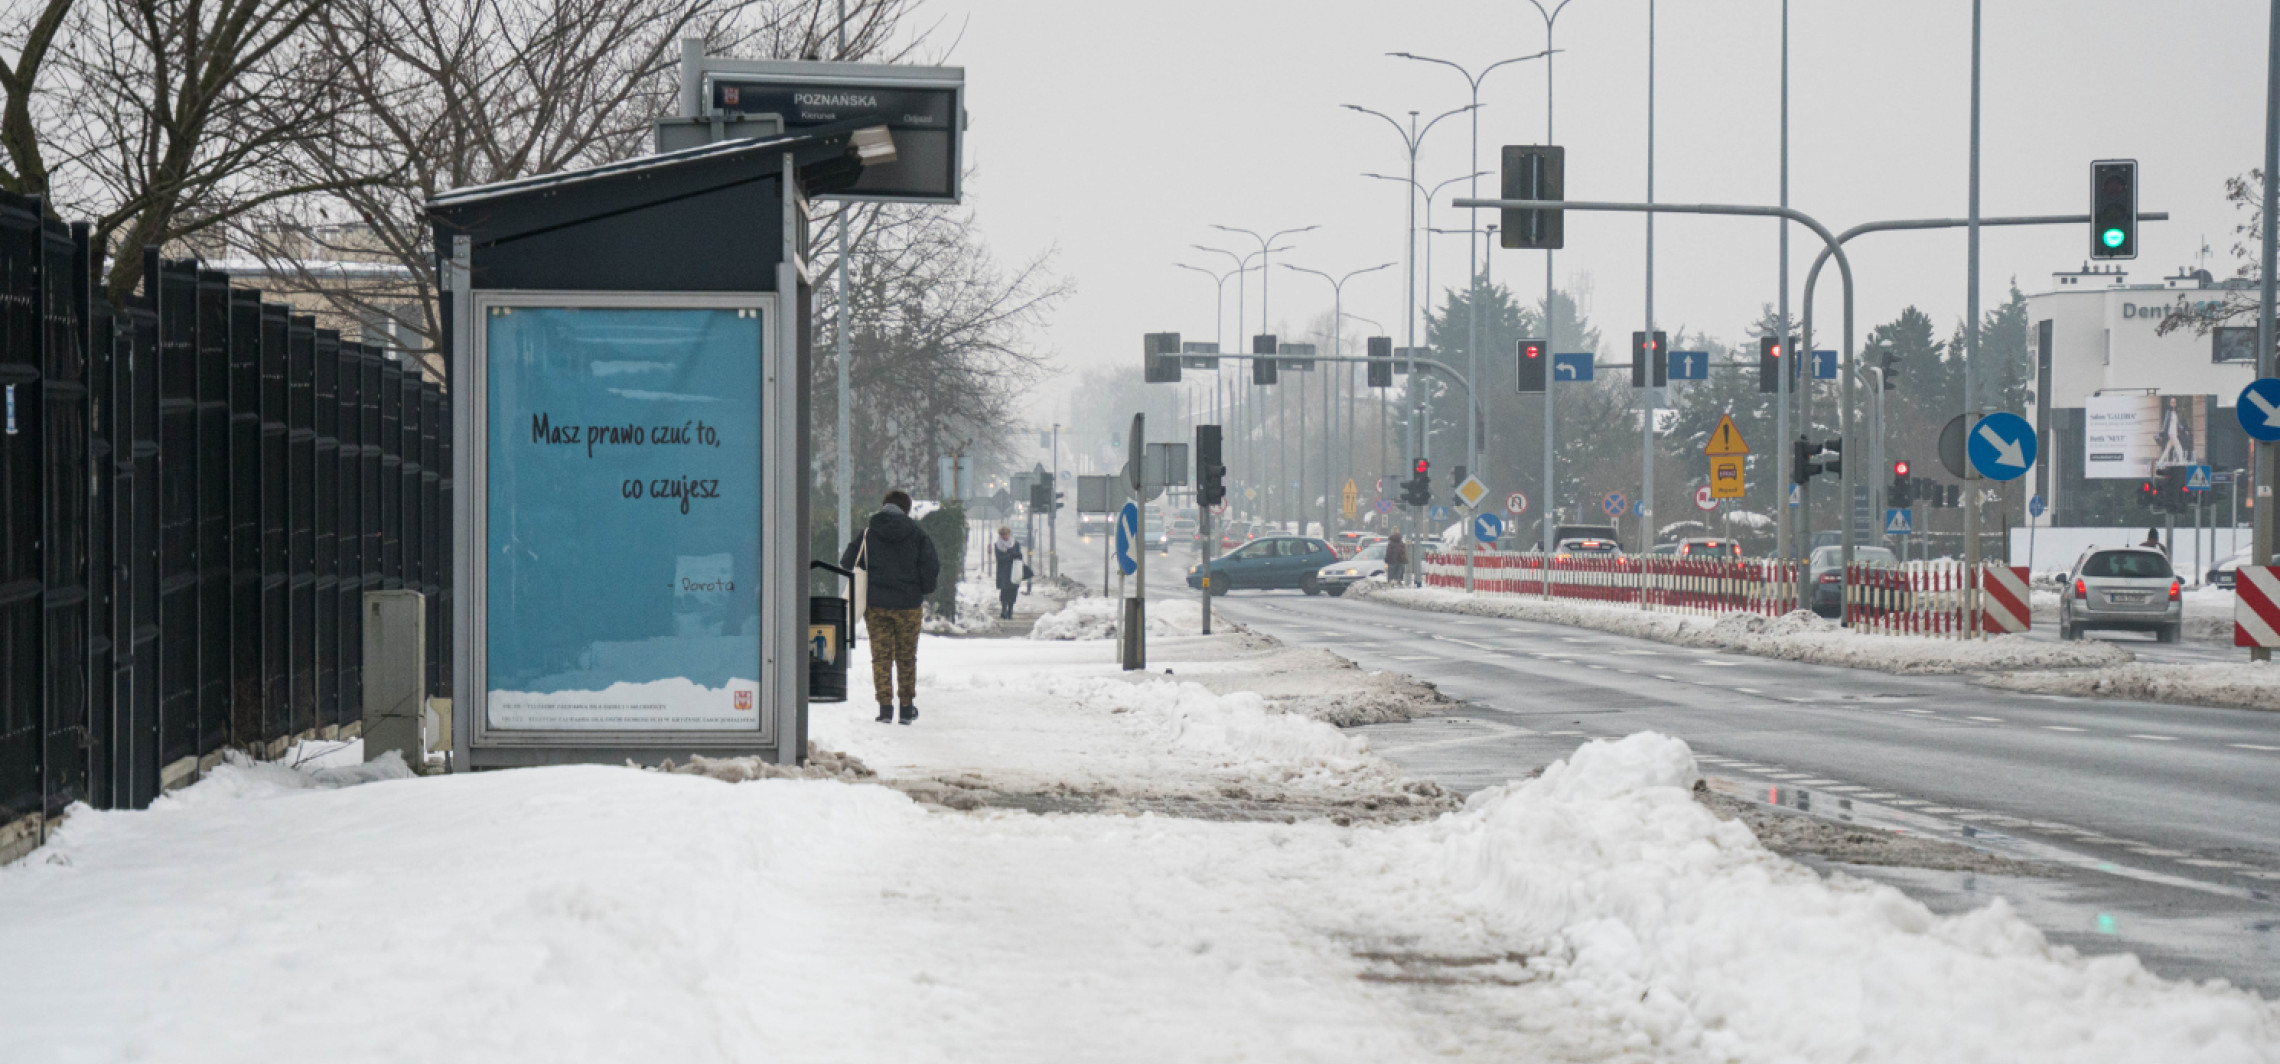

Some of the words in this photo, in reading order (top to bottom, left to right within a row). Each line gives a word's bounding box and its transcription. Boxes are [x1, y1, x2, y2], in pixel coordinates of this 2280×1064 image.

[794, 92, 877, 107] POZNAŃSKA
[532, 412, 581, 444] Masz
[587, 424, 644, 458] prawo
[651, 420, 692, 445] czuć
[696, 420, 720, 448] to,
[622, 479, 643, 499] co
[650, 475, 720, 514] czujesz
[682, 577, 736, 591] Dorota
